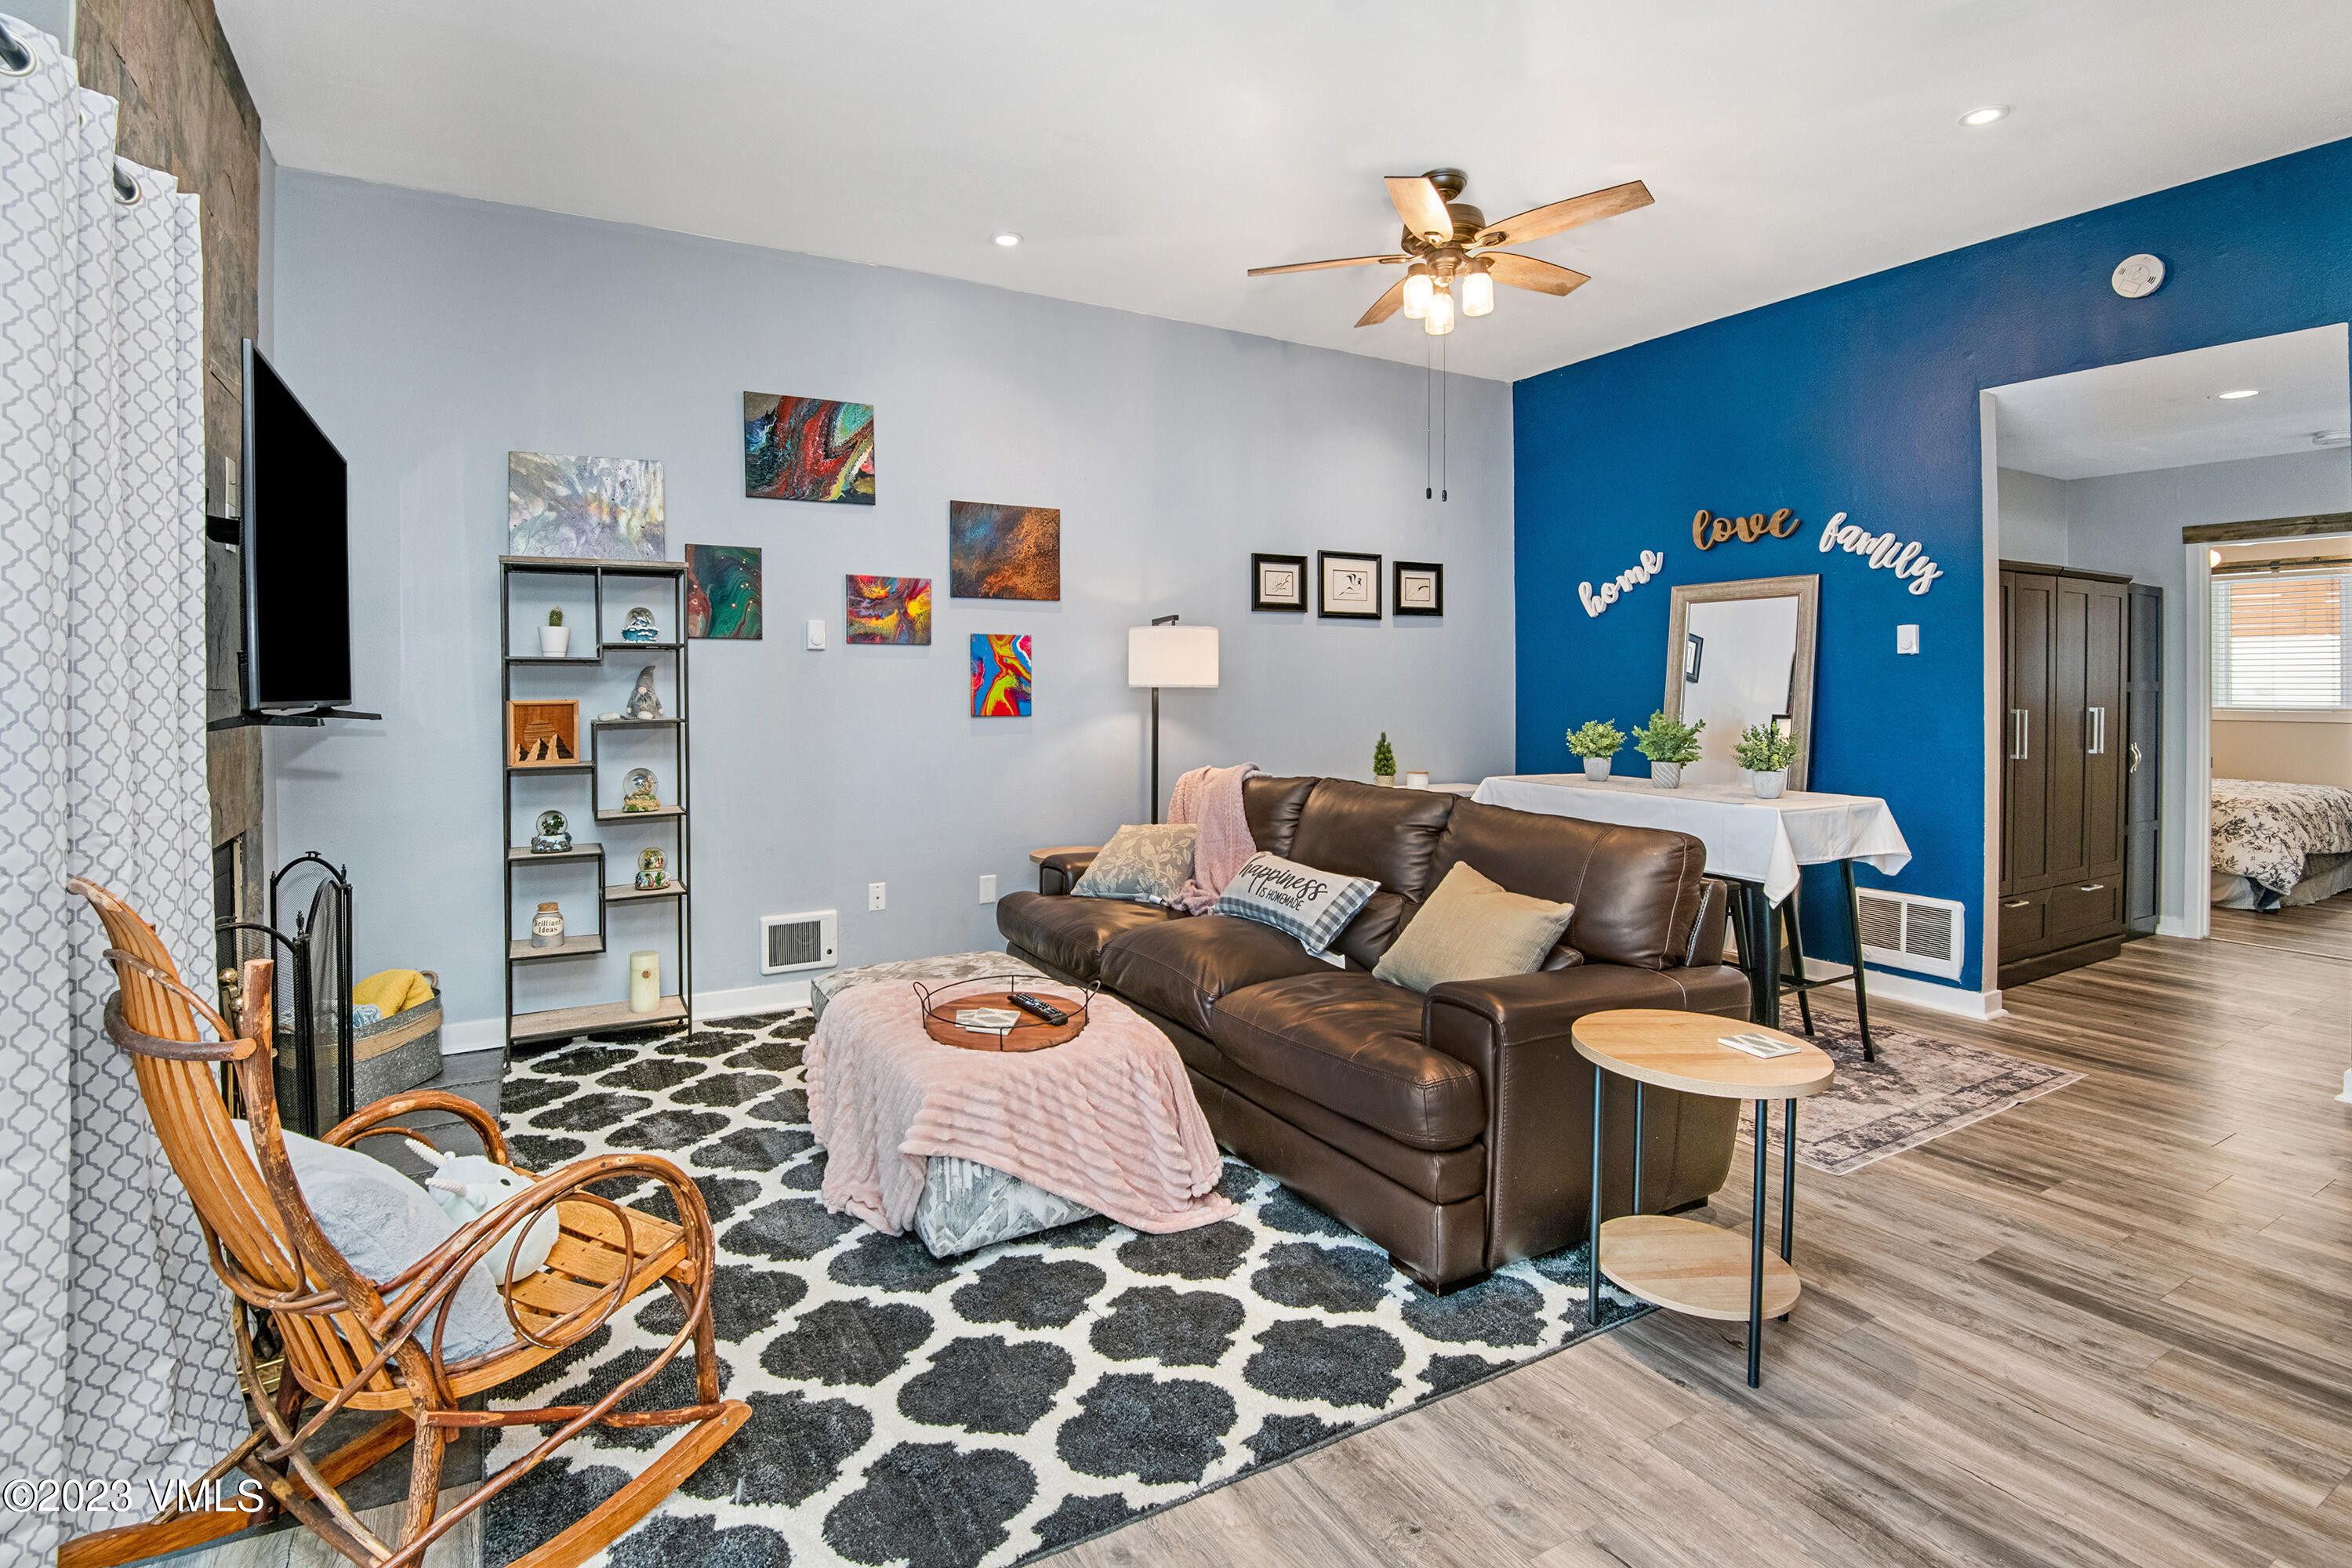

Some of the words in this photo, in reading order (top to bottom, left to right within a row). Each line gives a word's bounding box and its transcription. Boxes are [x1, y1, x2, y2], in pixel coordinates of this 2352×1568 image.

[1578, 550, 1664, 618] home
[1692, 508, 1802, 551] love
[1818, 511, 1944, 595] family
[1239, 855, 1328, 901] happiness
[1259, 887, 1268, 898] IS
[1268, 889, 1305, 911] HOMEMADE
